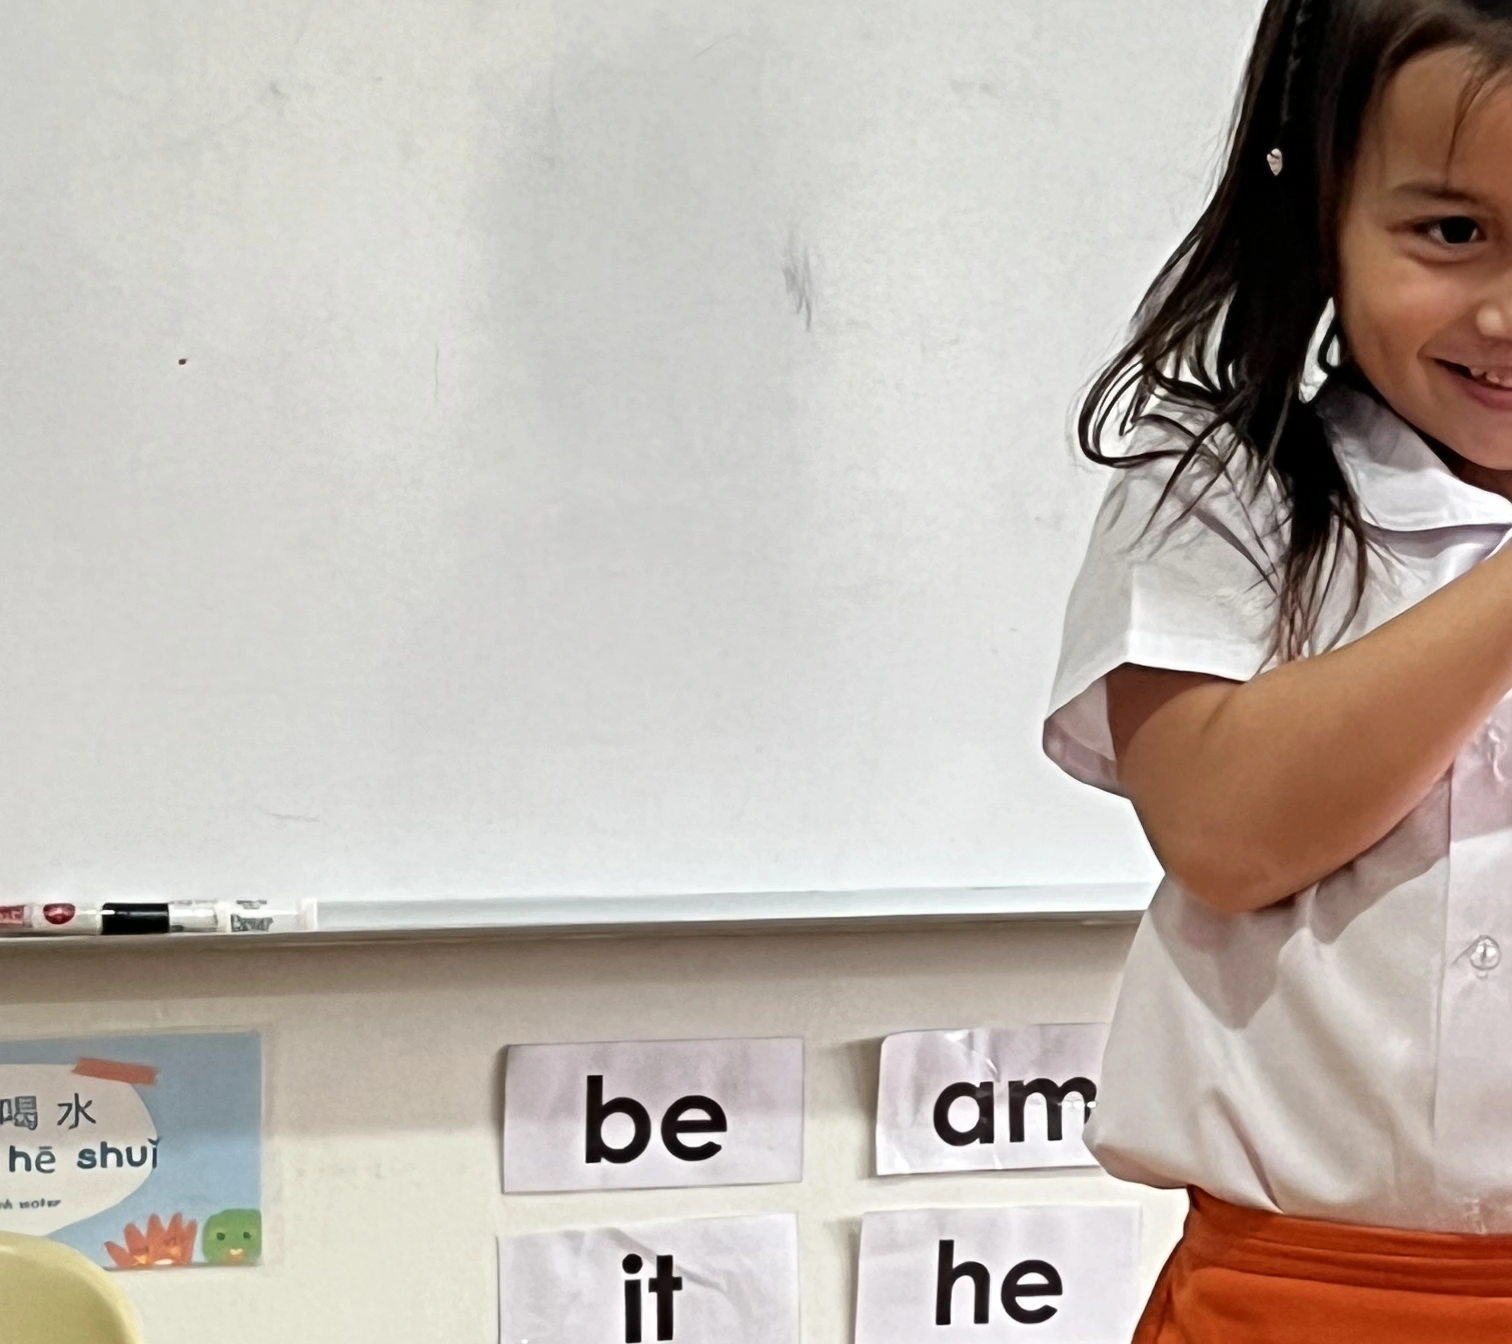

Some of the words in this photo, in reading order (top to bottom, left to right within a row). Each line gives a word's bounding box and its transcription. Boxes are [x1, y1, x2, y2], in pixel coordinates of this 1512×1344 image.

[585, 1074, 728, 1164] be
[932, 1076, 1098, 1147] am
[9, 1145, 56, 1174] hē
[622, 1253, 683, 1344] it
[935, 1239, 1063, 1325] he
